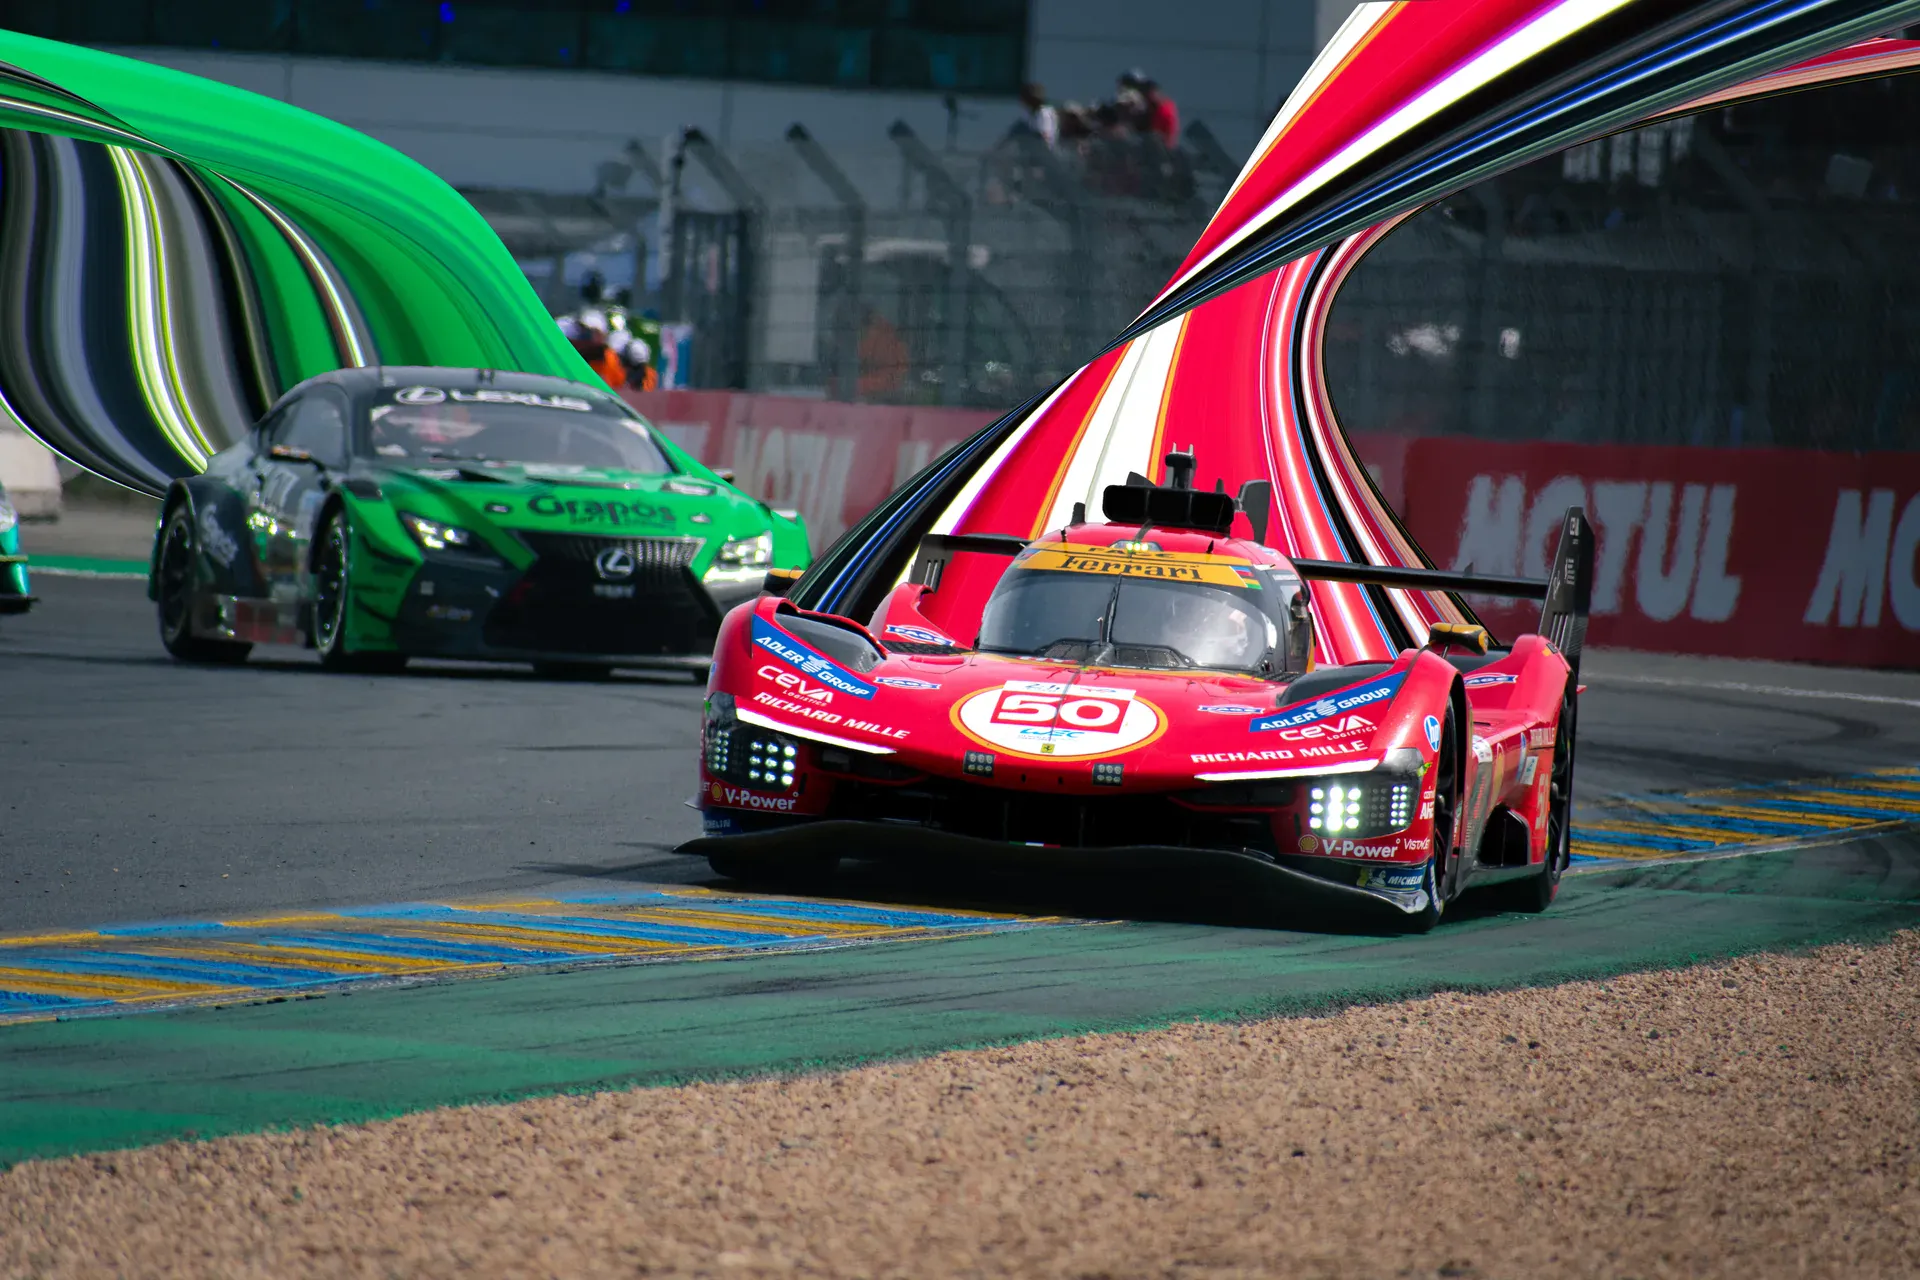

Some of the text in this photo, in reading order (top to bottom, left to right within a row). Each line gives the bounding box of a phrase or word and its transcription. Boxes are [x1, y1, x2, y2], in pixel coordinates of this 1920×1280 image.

[1450, 474, 1742, 622] MOTUL
[1056, 555, 1204, 581] Ferrari
[756, 636, 870, 696] ADLER GROUP
[753, 692, 911, 740] RICHARD MILLE
[997, 694, 1121, 727] 50
[1259, 687, 1392, 730] ADLER GROUP
[1326, 725, 1379, 741] LOGISTICS
[1190, 739, 1369, 763] RICHARD MILLE
[725, 788, 796, 810] V-Power
[1322, 839, 1398, 858] V-Power
